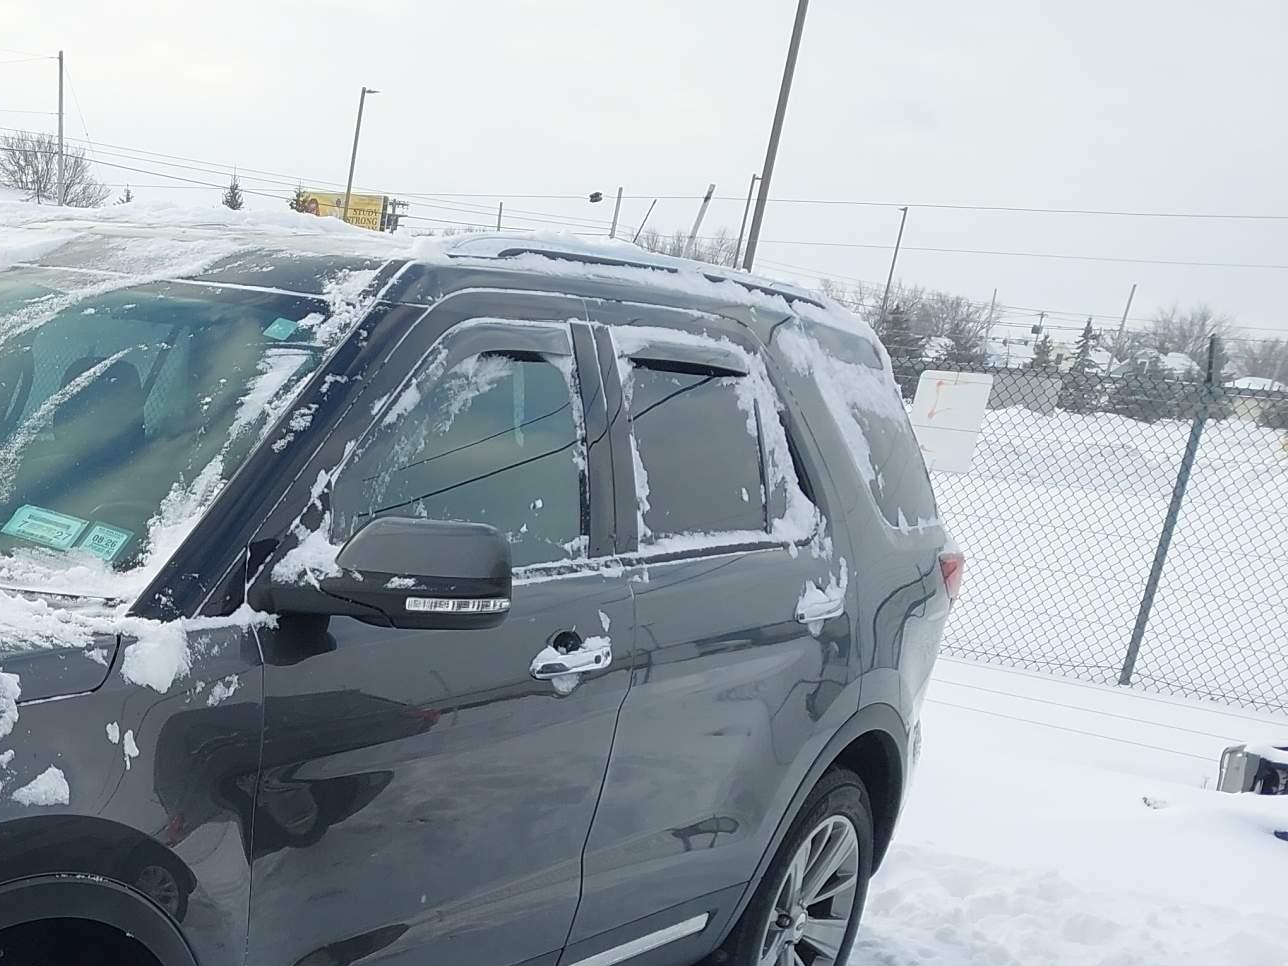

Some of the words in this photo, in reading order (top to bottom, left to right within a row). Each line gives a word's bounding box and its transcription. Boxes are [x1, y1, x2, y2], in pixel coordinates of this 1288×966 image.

[352, 208, 377, 216] STUDY
[347, 216, 377, 226] STRONG
[53, 530, 73, 541] 27
